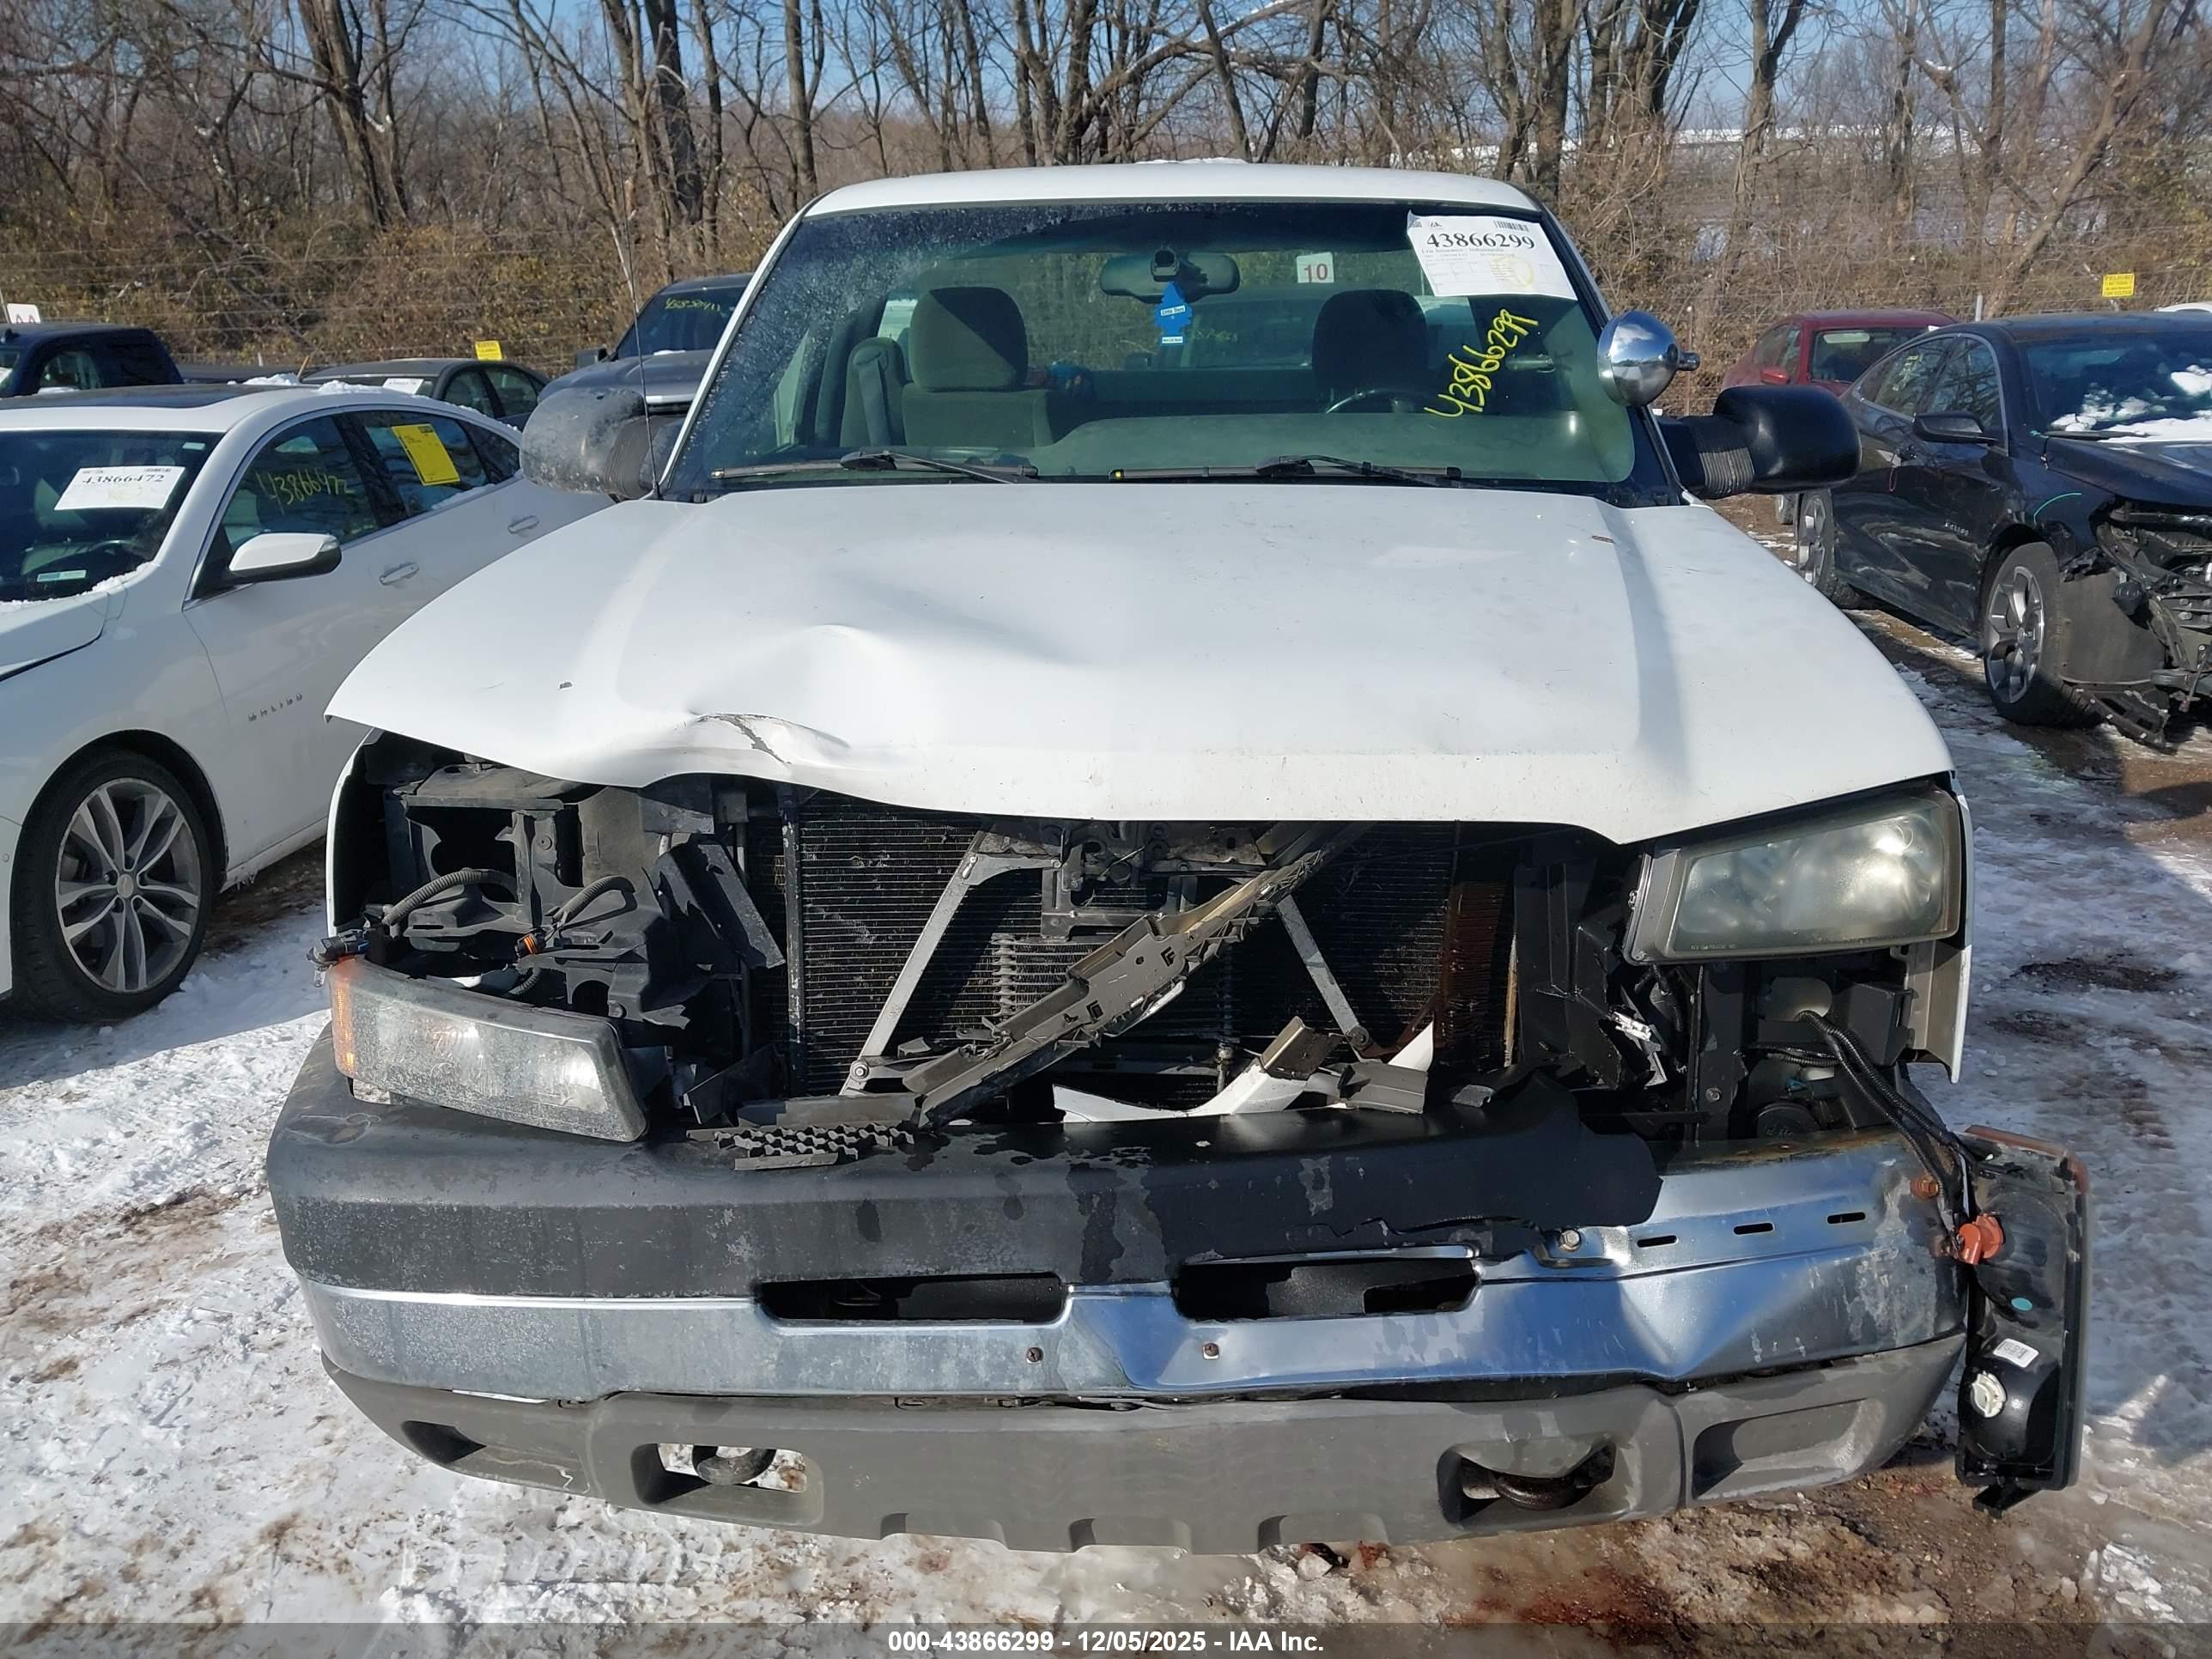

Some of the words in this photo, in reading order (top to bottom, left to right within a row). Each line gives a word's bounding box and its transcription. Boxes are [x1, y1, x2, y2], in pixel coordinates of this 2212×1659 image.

[1426, 233, 1535, 249] 43866299
[1304, 263, 1328, 283] 10
[1423, 309, 1539, 417] 43866299
[82, 474, 165, 484] 43866472
[255, 467, 355, 515] 43866472
